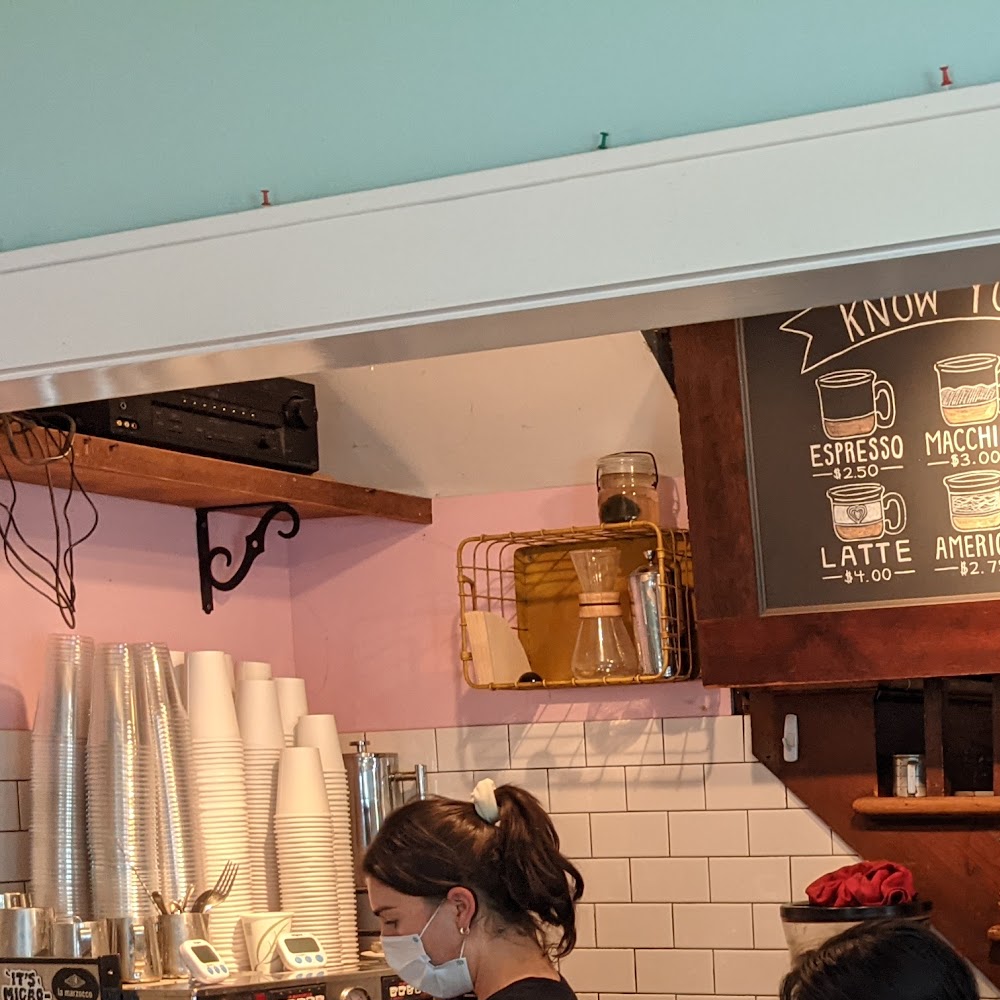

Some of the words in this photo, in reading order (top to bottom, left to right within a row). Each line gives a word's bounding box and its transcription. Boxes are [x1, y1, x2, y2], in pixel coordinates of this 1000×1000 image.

[839, 289, 938, 342] KNOW
[810, 434, 904, 468] ESPRESSO
[950, 451, 1000, 468] $3.00
[832, 464, 879, 480] $2.50
[820, 539, 912, 569] LATTE
[844, 568, 892, 584] $4.00
[11, 971, 36, 988] IT'S
